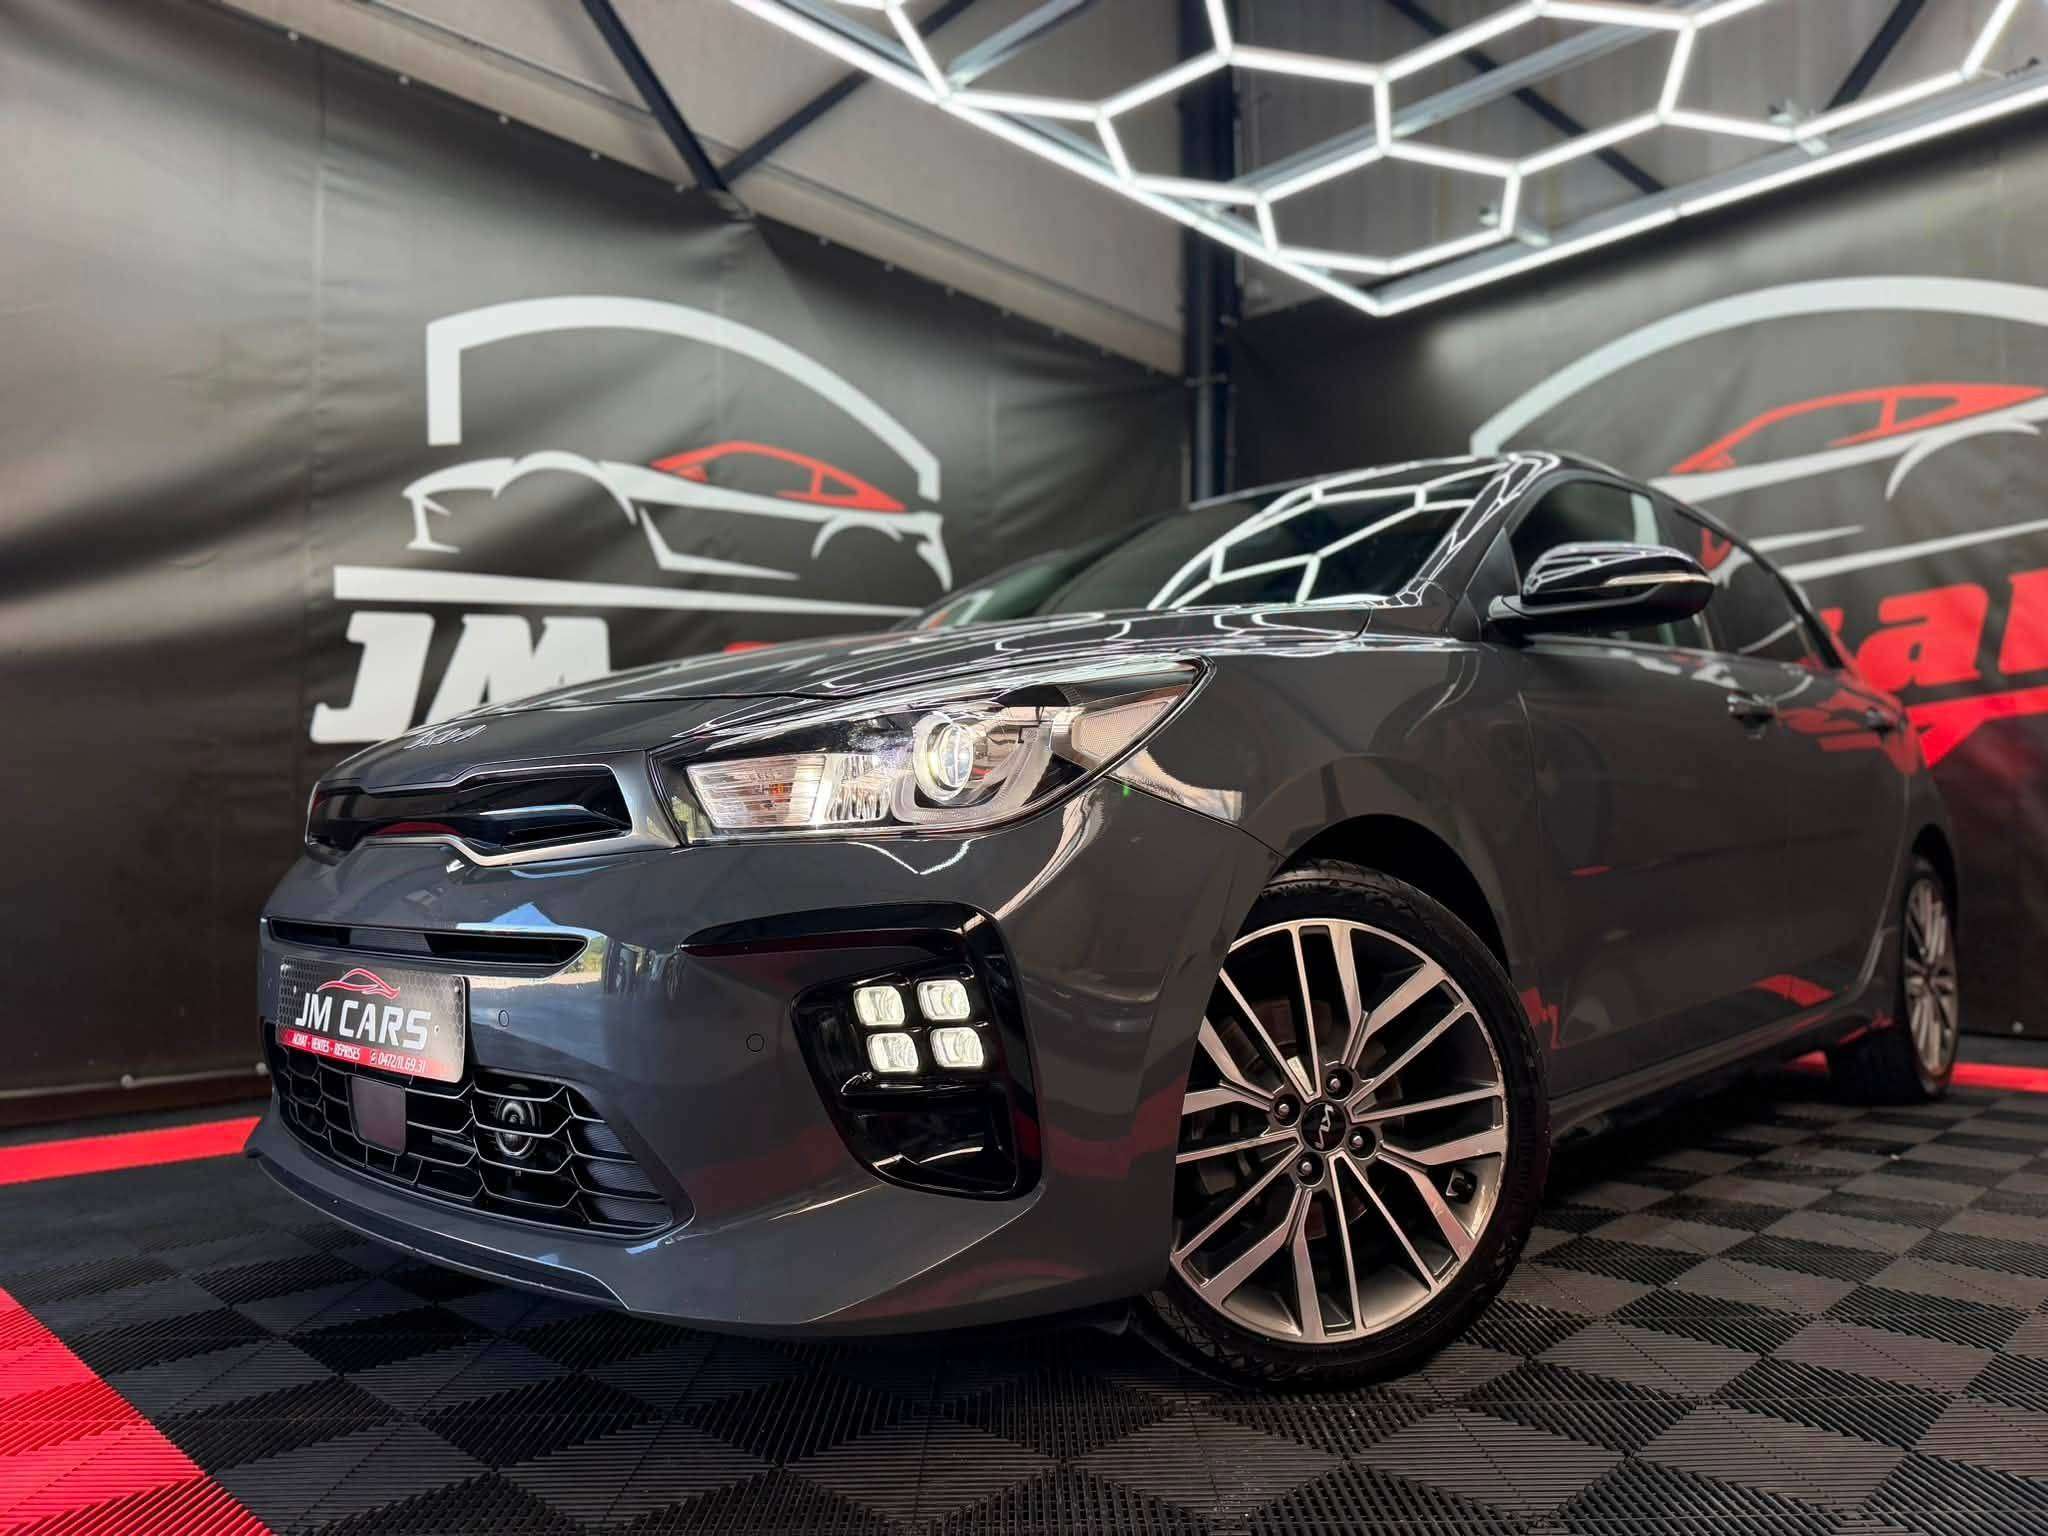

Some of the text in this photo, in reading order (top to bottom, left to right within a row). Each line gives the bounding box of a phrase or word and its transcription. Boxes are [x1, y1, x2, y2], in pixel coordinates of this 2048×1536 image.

[310, 611, 611, 743] JM
[292, 1032, 309, 1047] ACHAT
[311, 1036, 330, 1053] VENTES
[333, 1042, 361, 1061] REPRISES
[295, 992, 432, 1050] JM CARS
